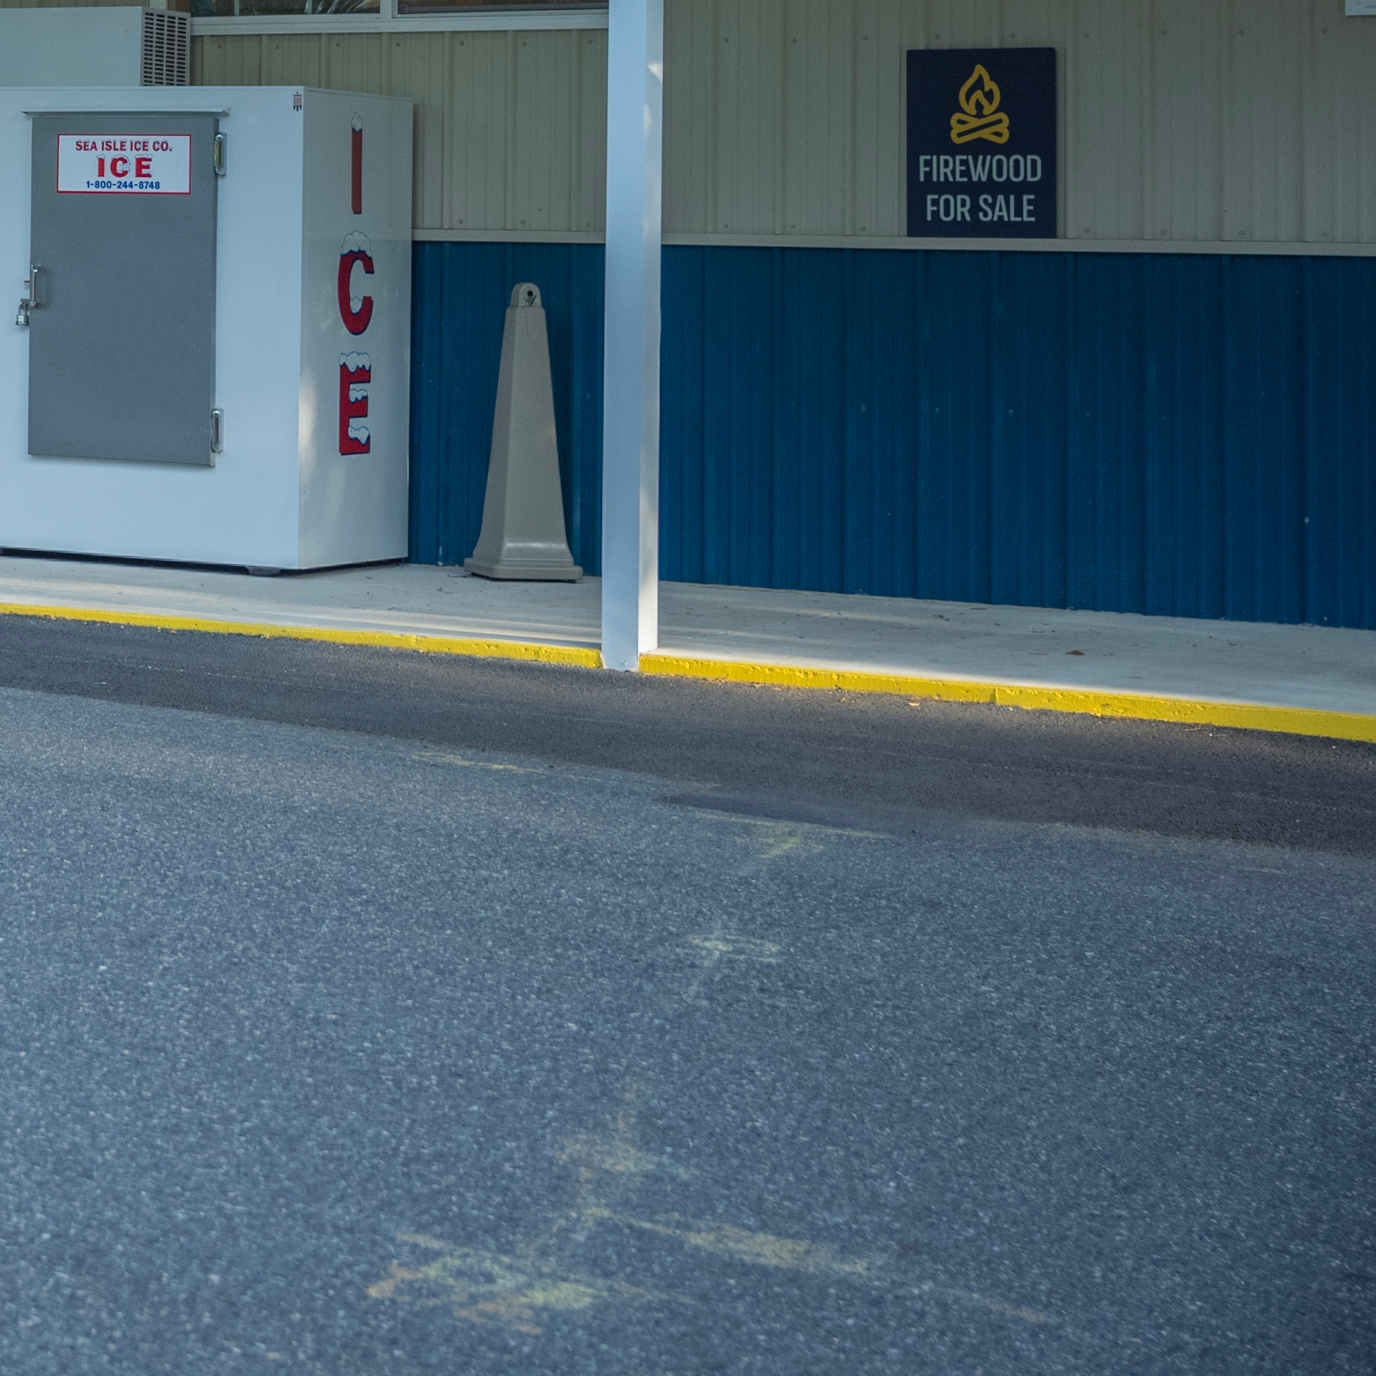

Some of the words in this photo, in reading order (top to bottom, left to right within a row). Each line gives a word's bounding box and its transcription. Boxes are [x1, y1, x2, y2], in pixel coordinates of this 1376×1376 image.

[75, 140, 98, 151] SEA
[101, 140, 127, 151] ISLE
[130, 140, 149, 151] ICE
[152, 141, 173, 151] CO.
[97, 154, 153, 178] ICE
[919, 154, 1042, 182] FIREWOOD
[86, 180, 160, 189] 1-800-244-8748
[926, 194, 971, 221] FOR
[978, 194, 1036, 221] SALE
[337, 112, 375, 455] ICE
